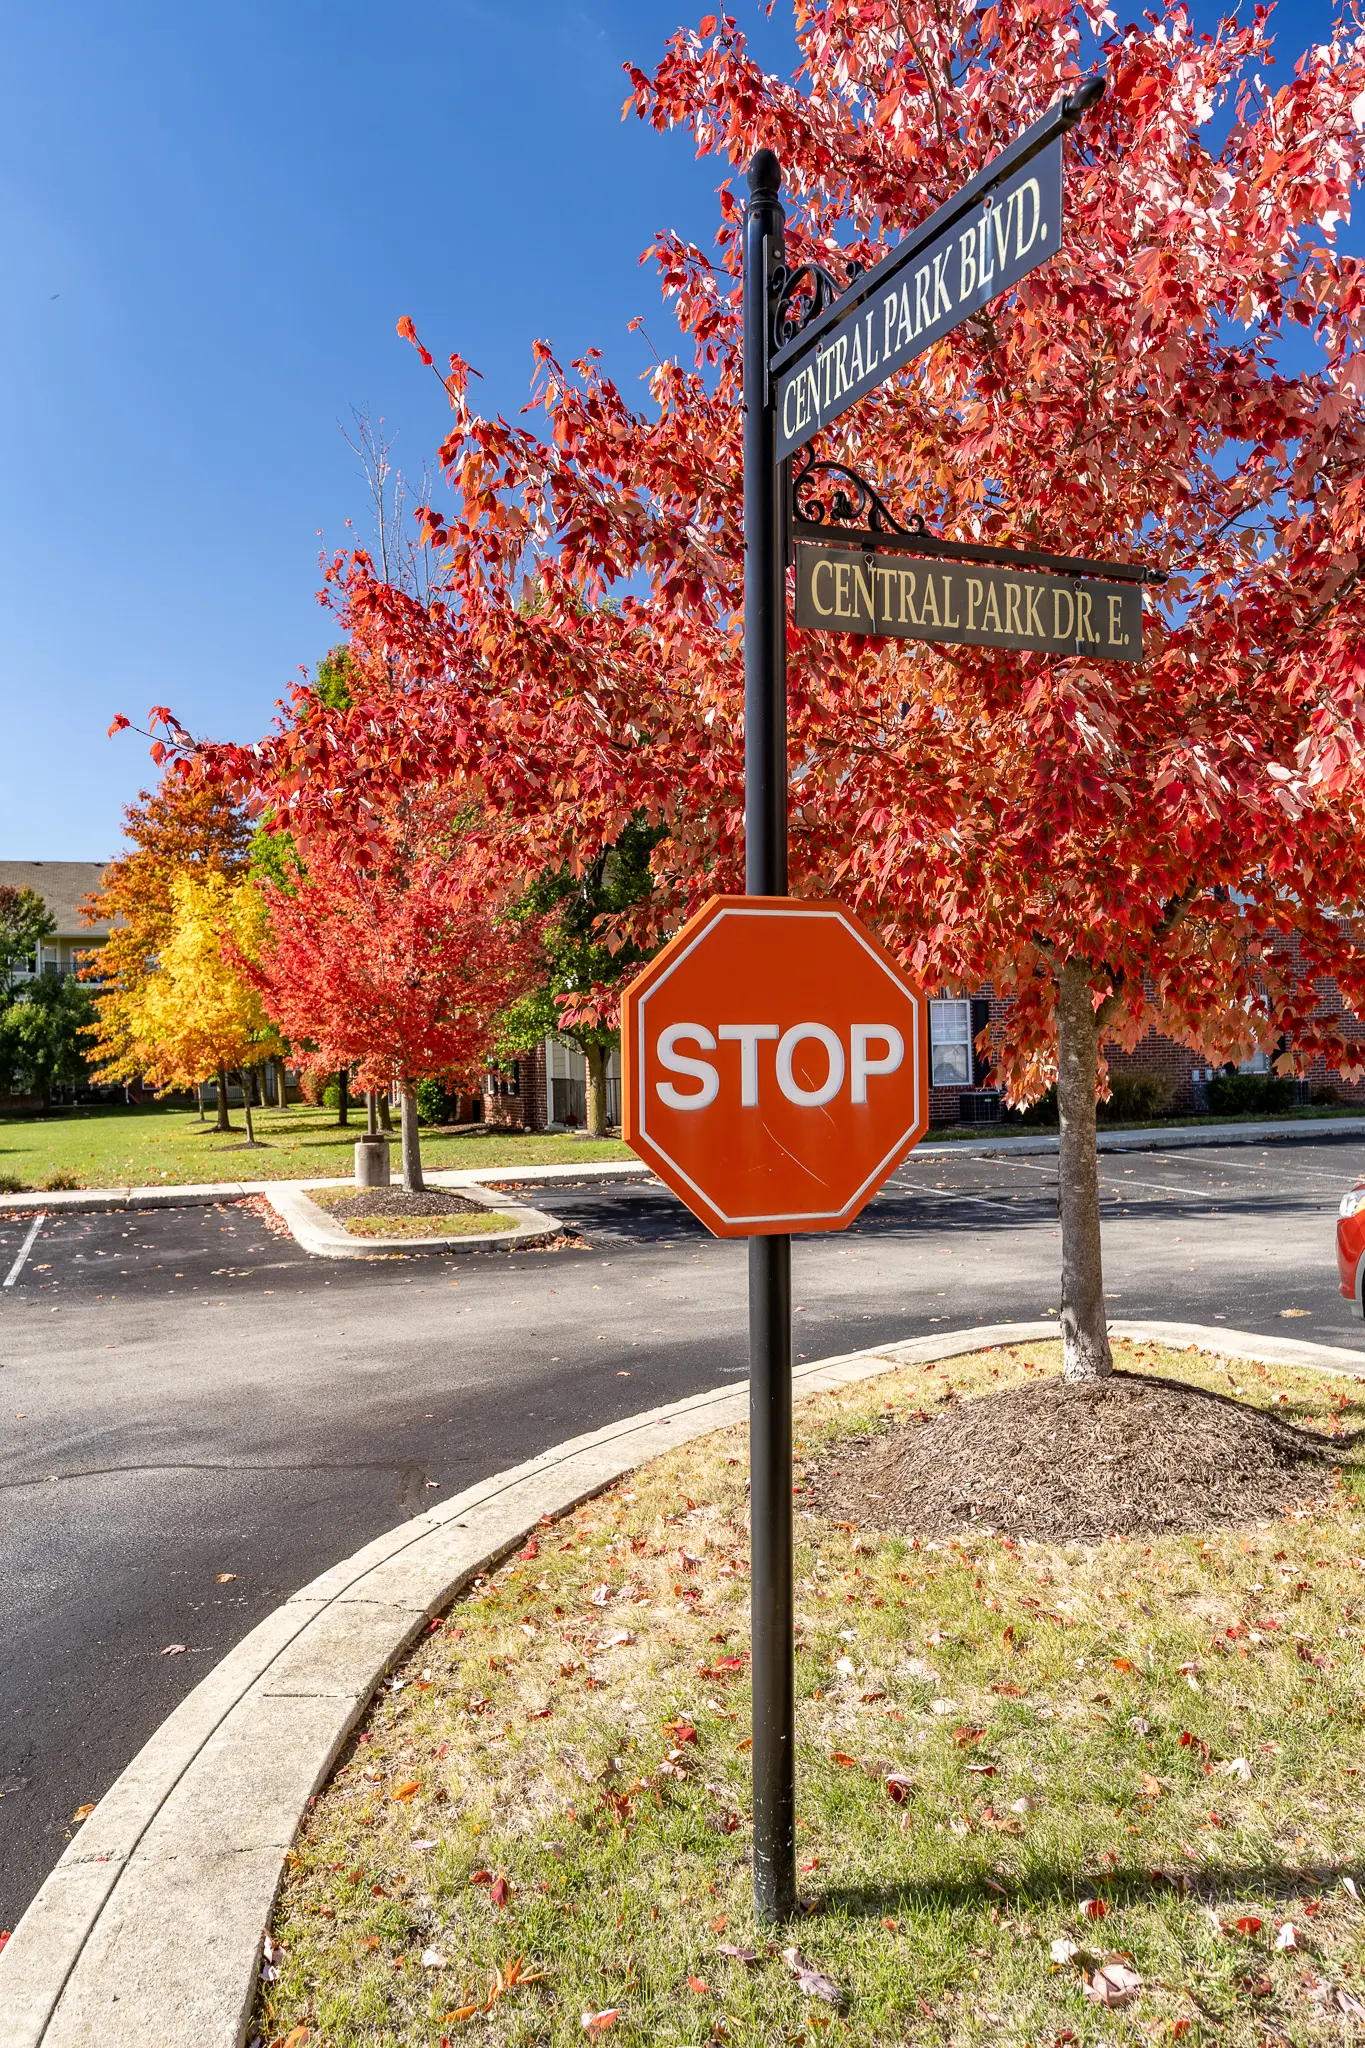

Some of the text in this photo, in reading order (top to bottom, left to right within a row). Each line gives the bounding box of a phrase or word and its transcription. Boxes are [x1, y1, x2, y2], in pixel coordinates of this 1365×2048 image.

[783, 177, 1048, 439] CENTRAL PARK BLVD.
[811, 560, 1129, 645] CENTRAL PARK DR. E.
[655, 1022, 905, 1111] STOP
